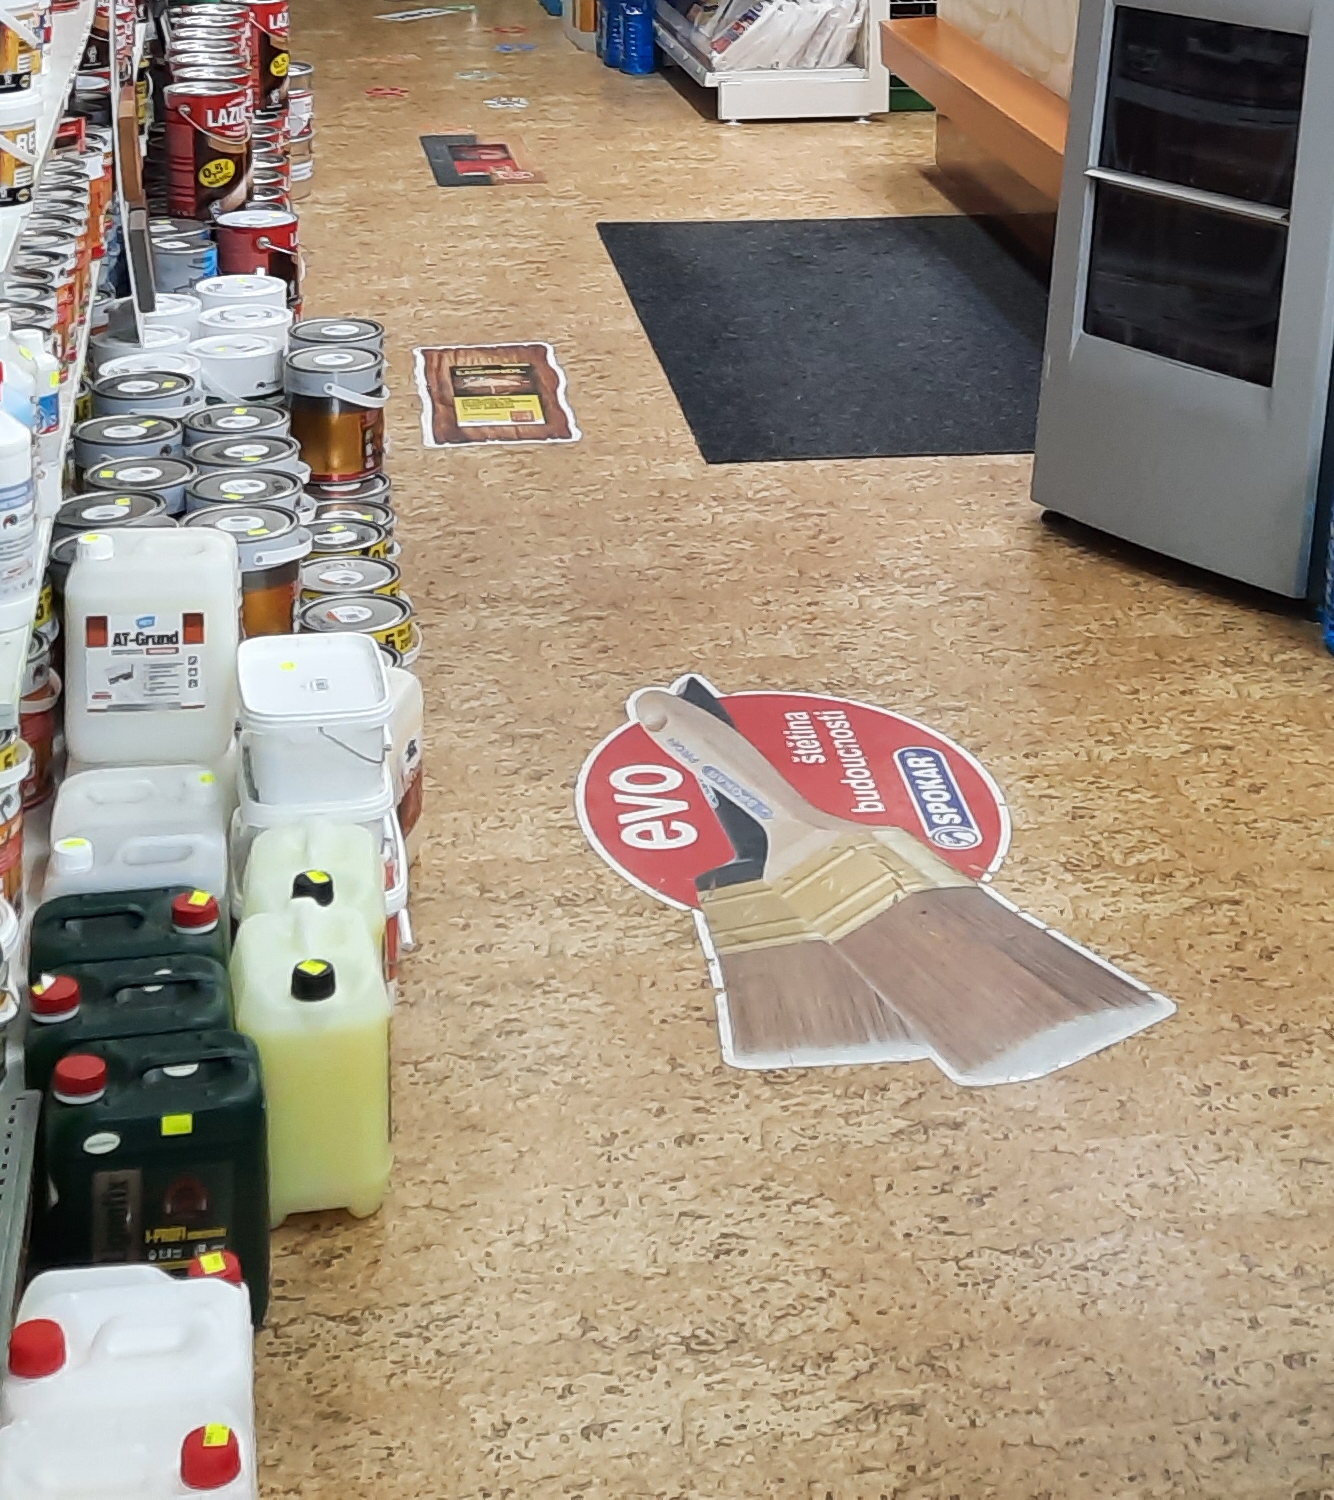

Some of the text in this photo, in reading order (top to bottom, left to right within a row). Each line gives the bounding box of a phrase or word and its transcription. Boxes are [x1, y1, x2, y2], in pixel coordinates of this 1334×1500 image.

[783, 711, 825, 765] štětina
[815, 709, 886, 814] budoucnosti
[608, 764, 699, 850] evo
[902, 753, 964, 827] SPOKAR
